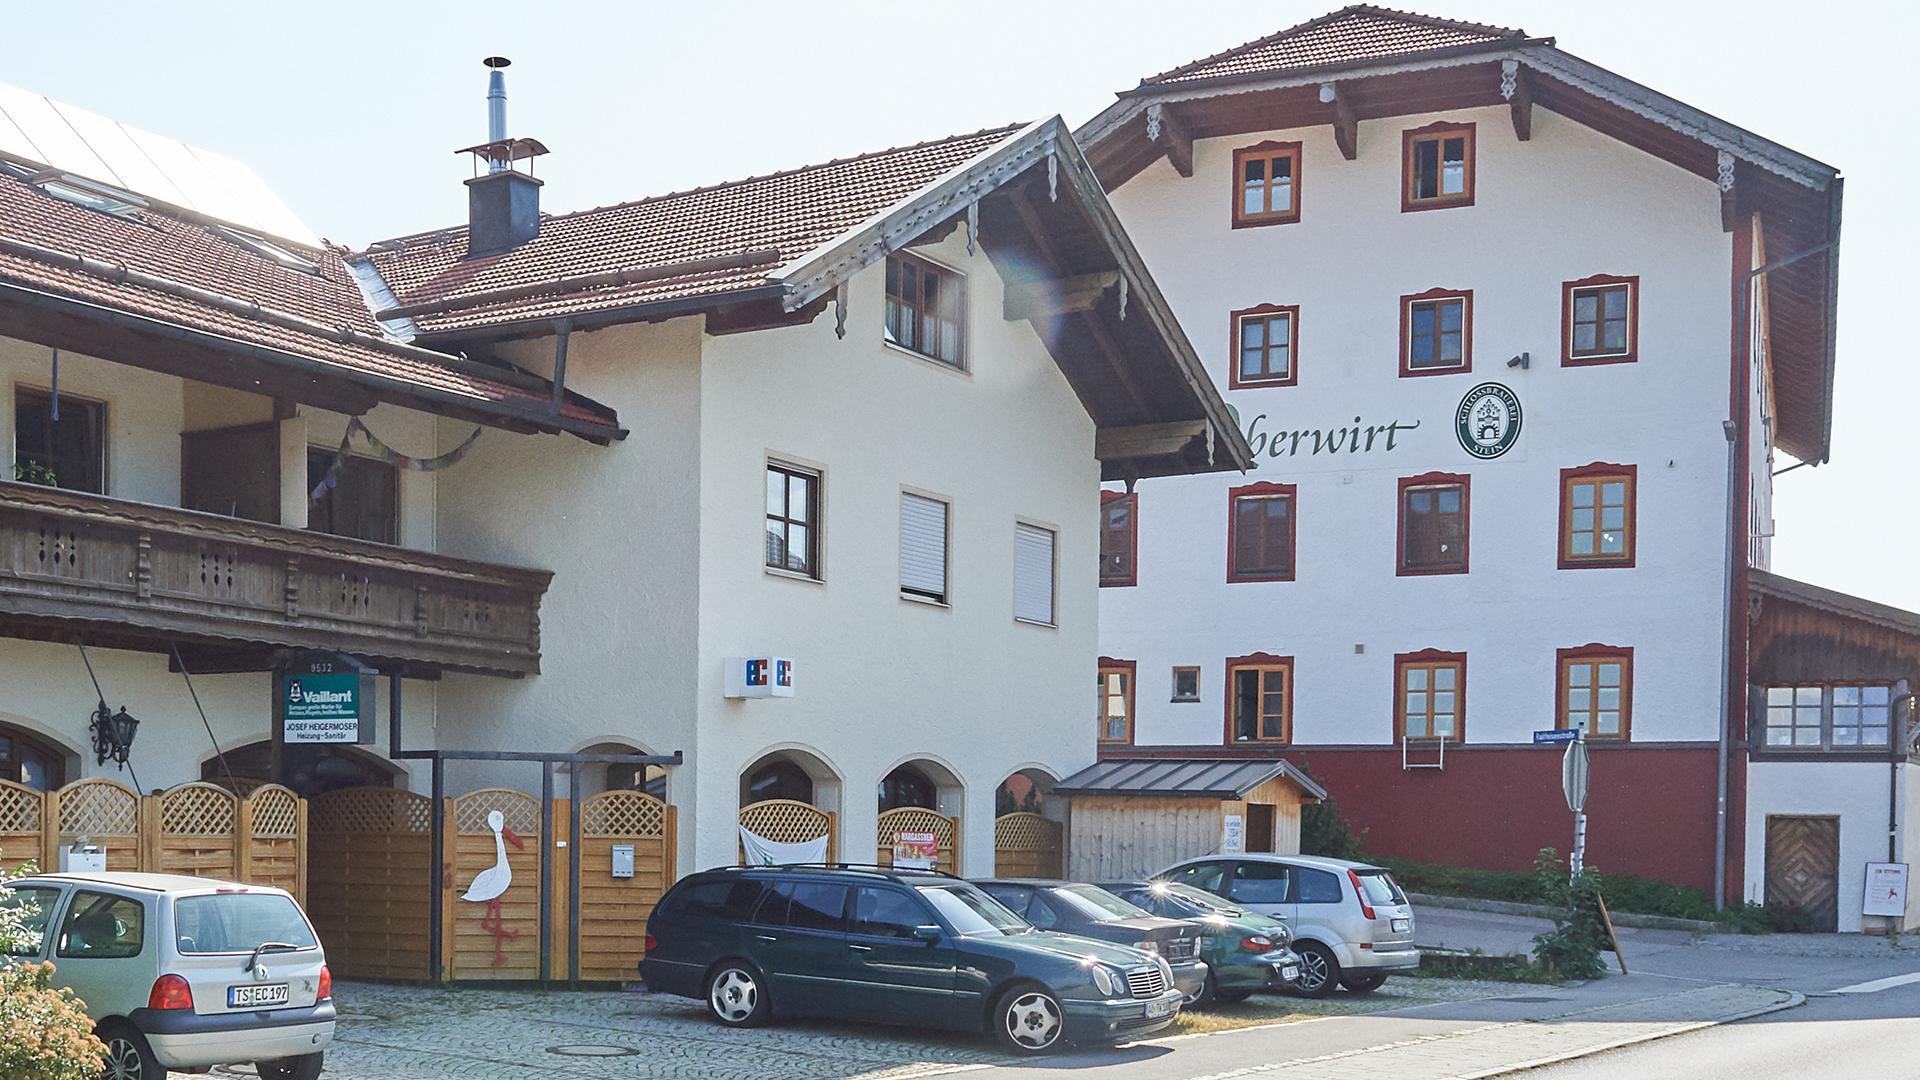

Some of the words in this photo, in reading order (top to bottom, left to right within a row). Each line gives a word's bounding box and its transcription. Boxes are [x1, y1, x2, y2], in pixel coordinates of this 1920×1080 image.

[1473, 443, 1503, 455] STEIN
[303, 690, 352, 703] Vaillant
[286, 722, 307, 731] JOSEF
[308, 722, 358, 731] HEIGERMOSER
[236, 989, 249, 1002] TS
[255, 987, 269, 1001] EC
[270, 986, 287, 1000] 197
